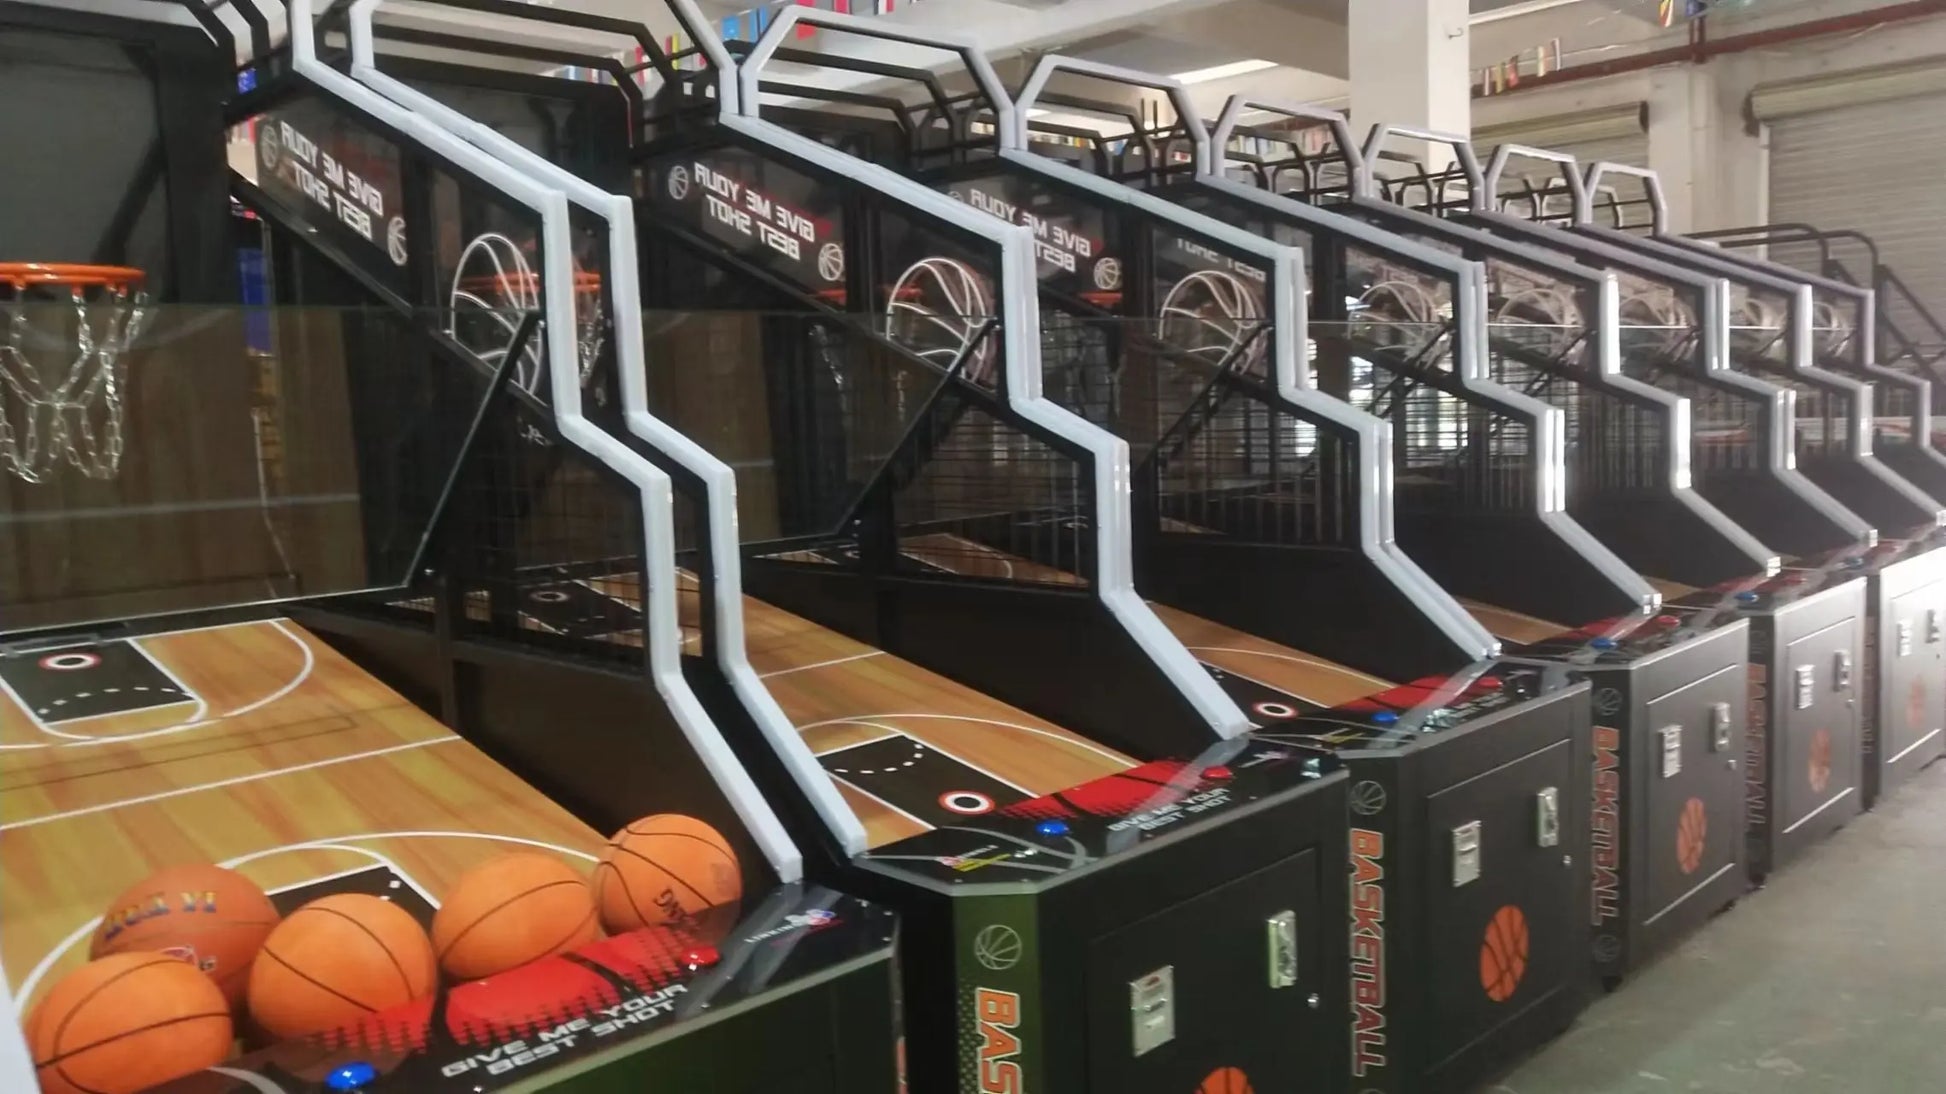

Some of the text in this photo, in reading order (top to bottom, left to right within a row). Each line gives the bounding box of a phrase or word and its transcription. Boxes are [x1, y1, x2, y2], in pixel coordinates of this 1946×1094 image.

[1591, 725, 1620, 926] BASKETBALL
[1349, 828, 1386, 1077] BASKETBALL
[441, 983, 688, 1078] GIVE ME YOUR
[486, 999, 675, 1075] BEST SHOT
